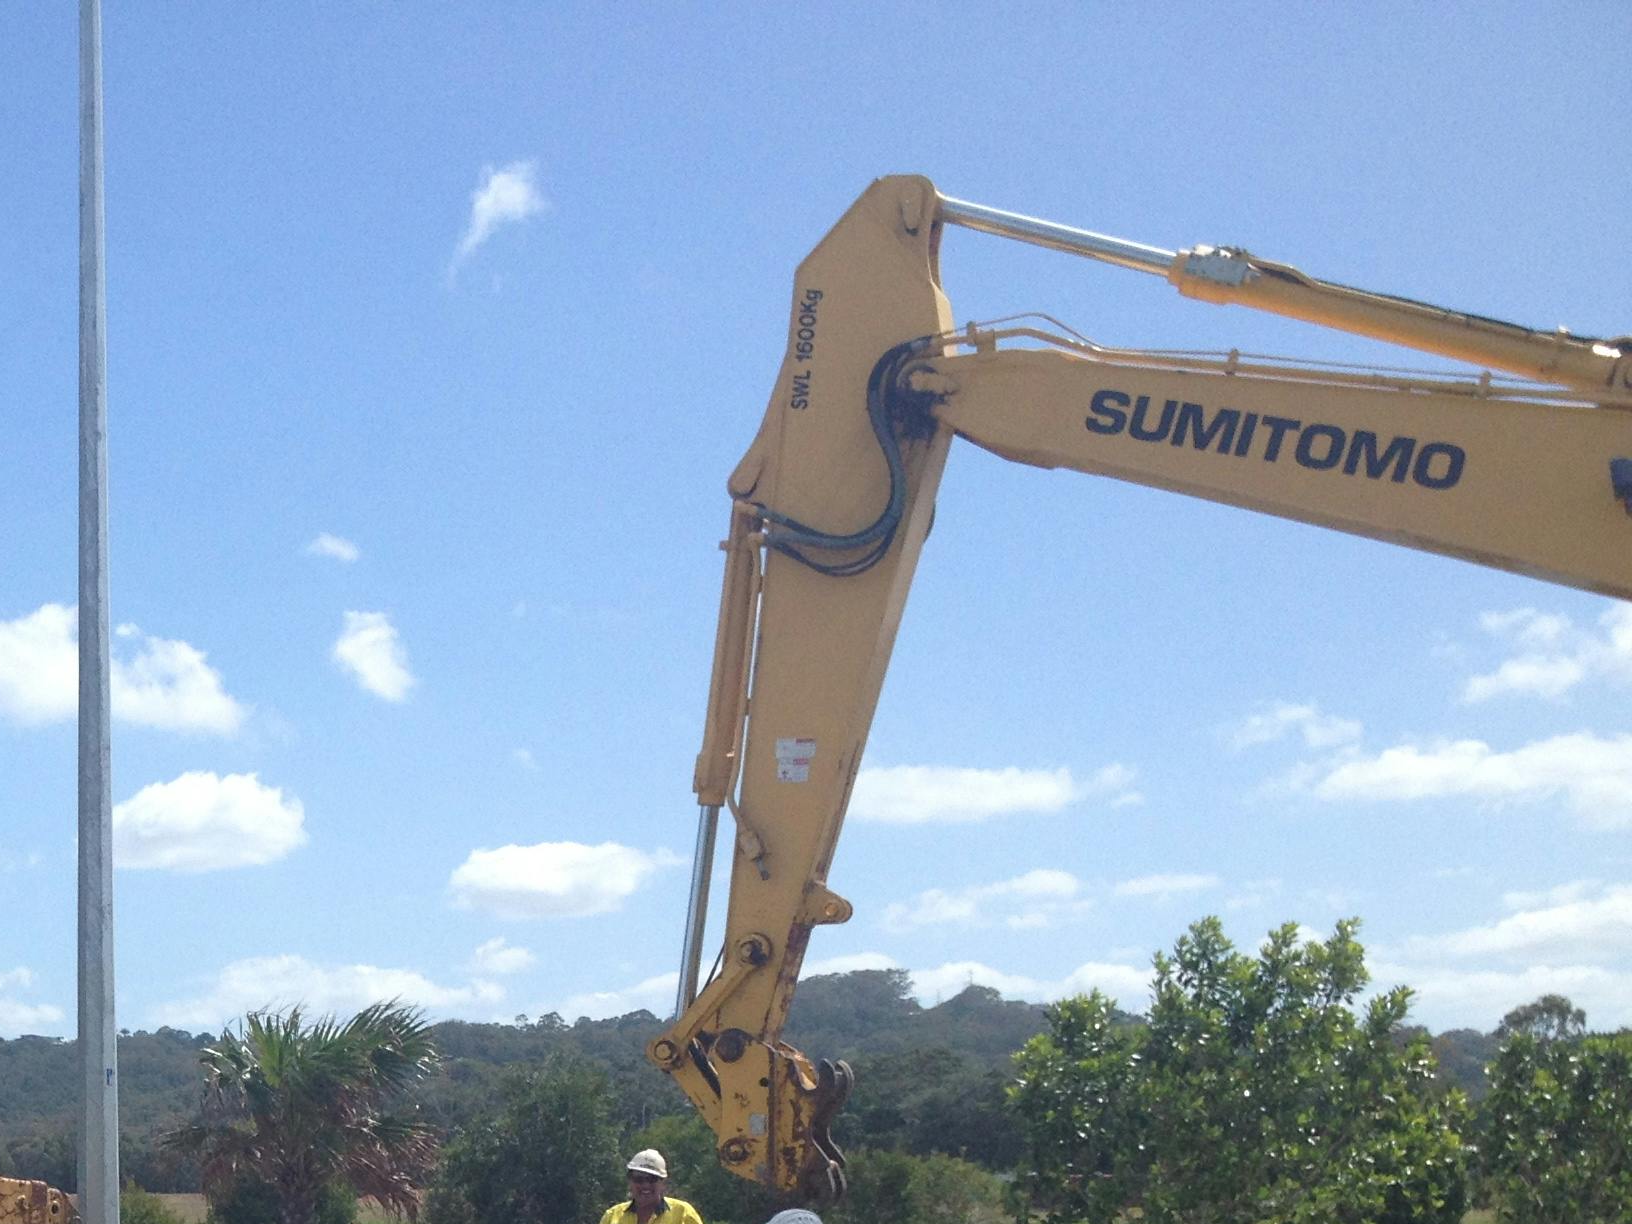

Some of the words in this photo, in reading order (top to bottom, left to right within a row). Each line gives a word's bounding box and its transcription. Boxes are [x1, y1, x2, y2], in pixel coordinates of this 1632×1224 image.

[795, 289, 824, 363] 1600Kg
[790, 370, 811, 410] SWL
[1084, 389, 1466, 490] SUMITOMO
